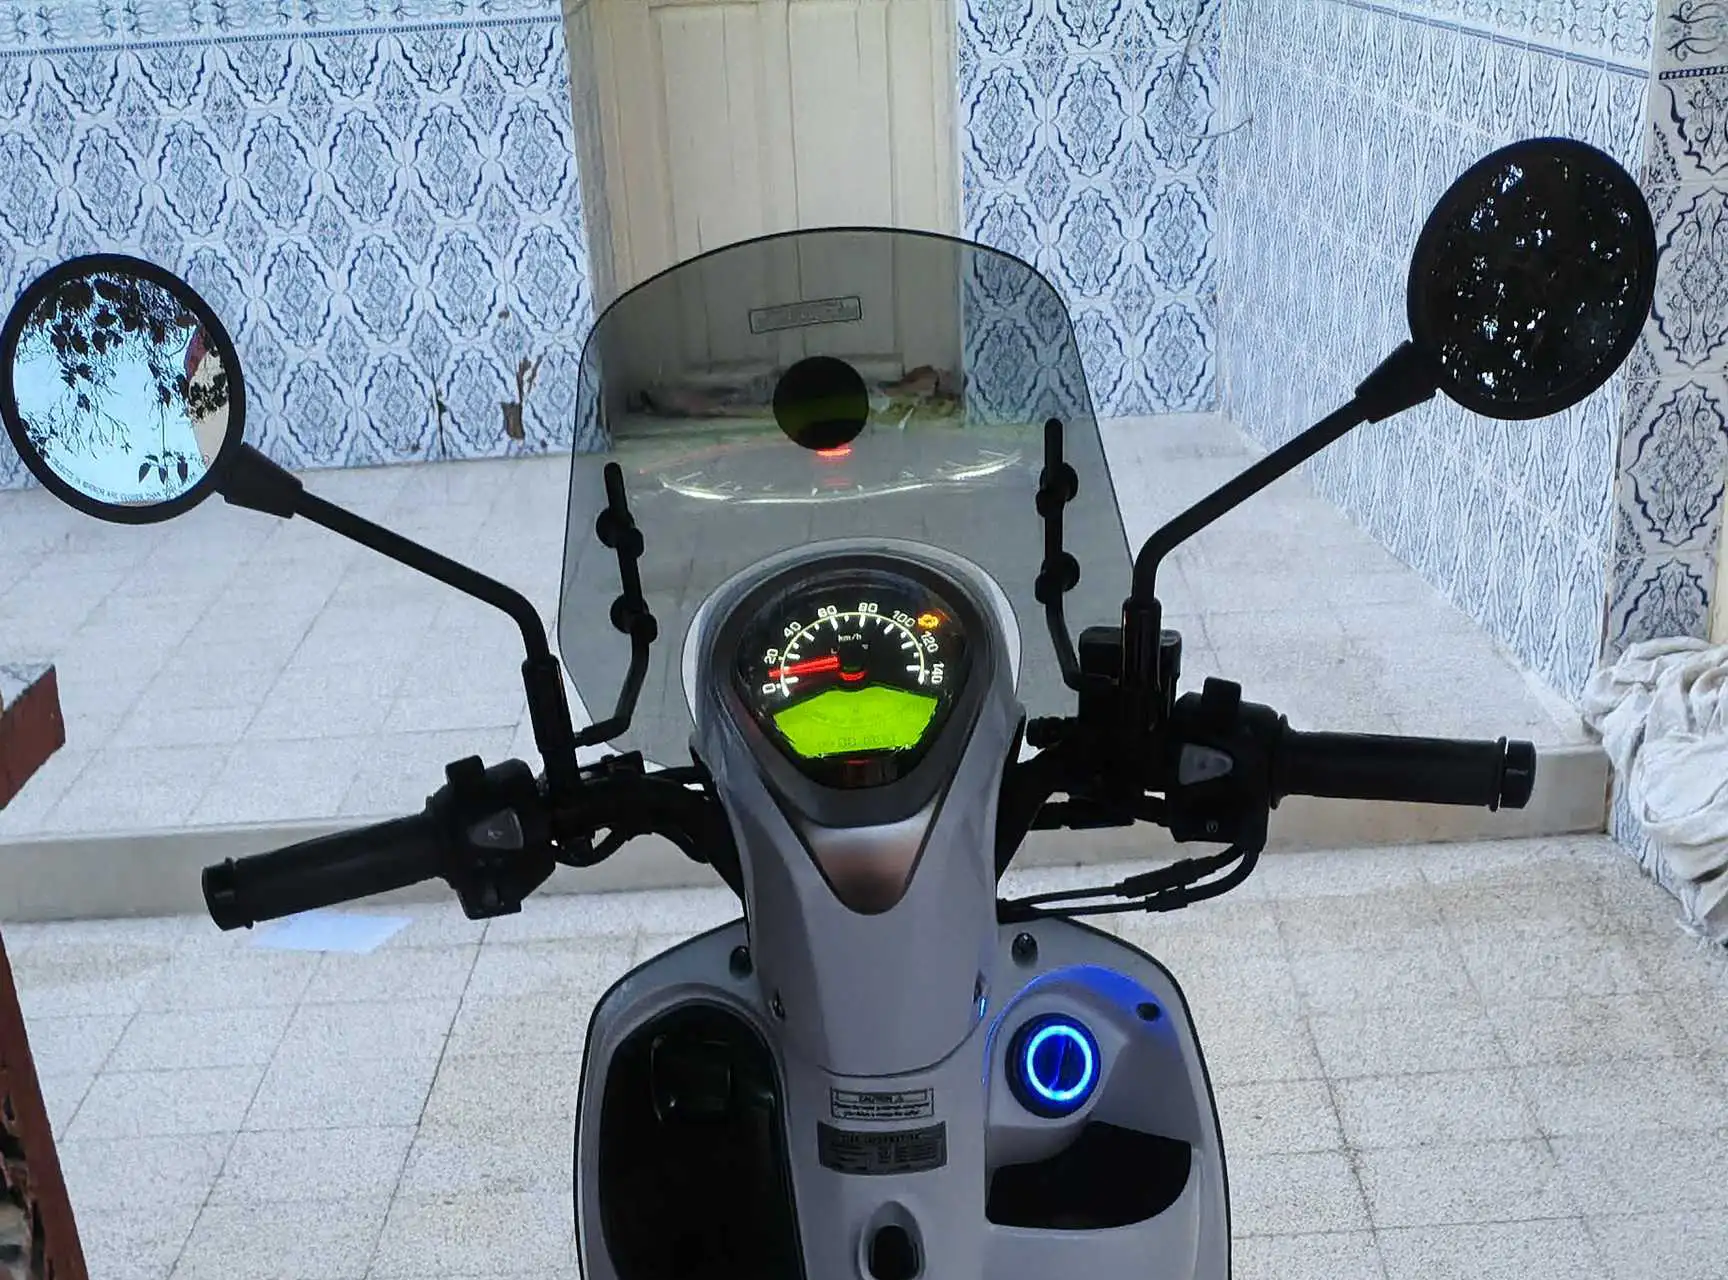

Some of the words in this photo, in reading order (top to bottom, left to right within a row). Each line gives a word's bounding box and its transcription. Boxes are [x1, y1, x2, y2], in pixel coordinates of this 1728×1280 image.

[817, 605, 838, 619] 60
[858, 602, 879, 614] 80
[892, 610, 916, 629] 100
[783, 621, 802, 639] 40
[921, 630, 939, 654] 120
[764, 648, 779, 665] 20
[931, 662, 945, 684] 140
[762, 682, 776, 695] 0
